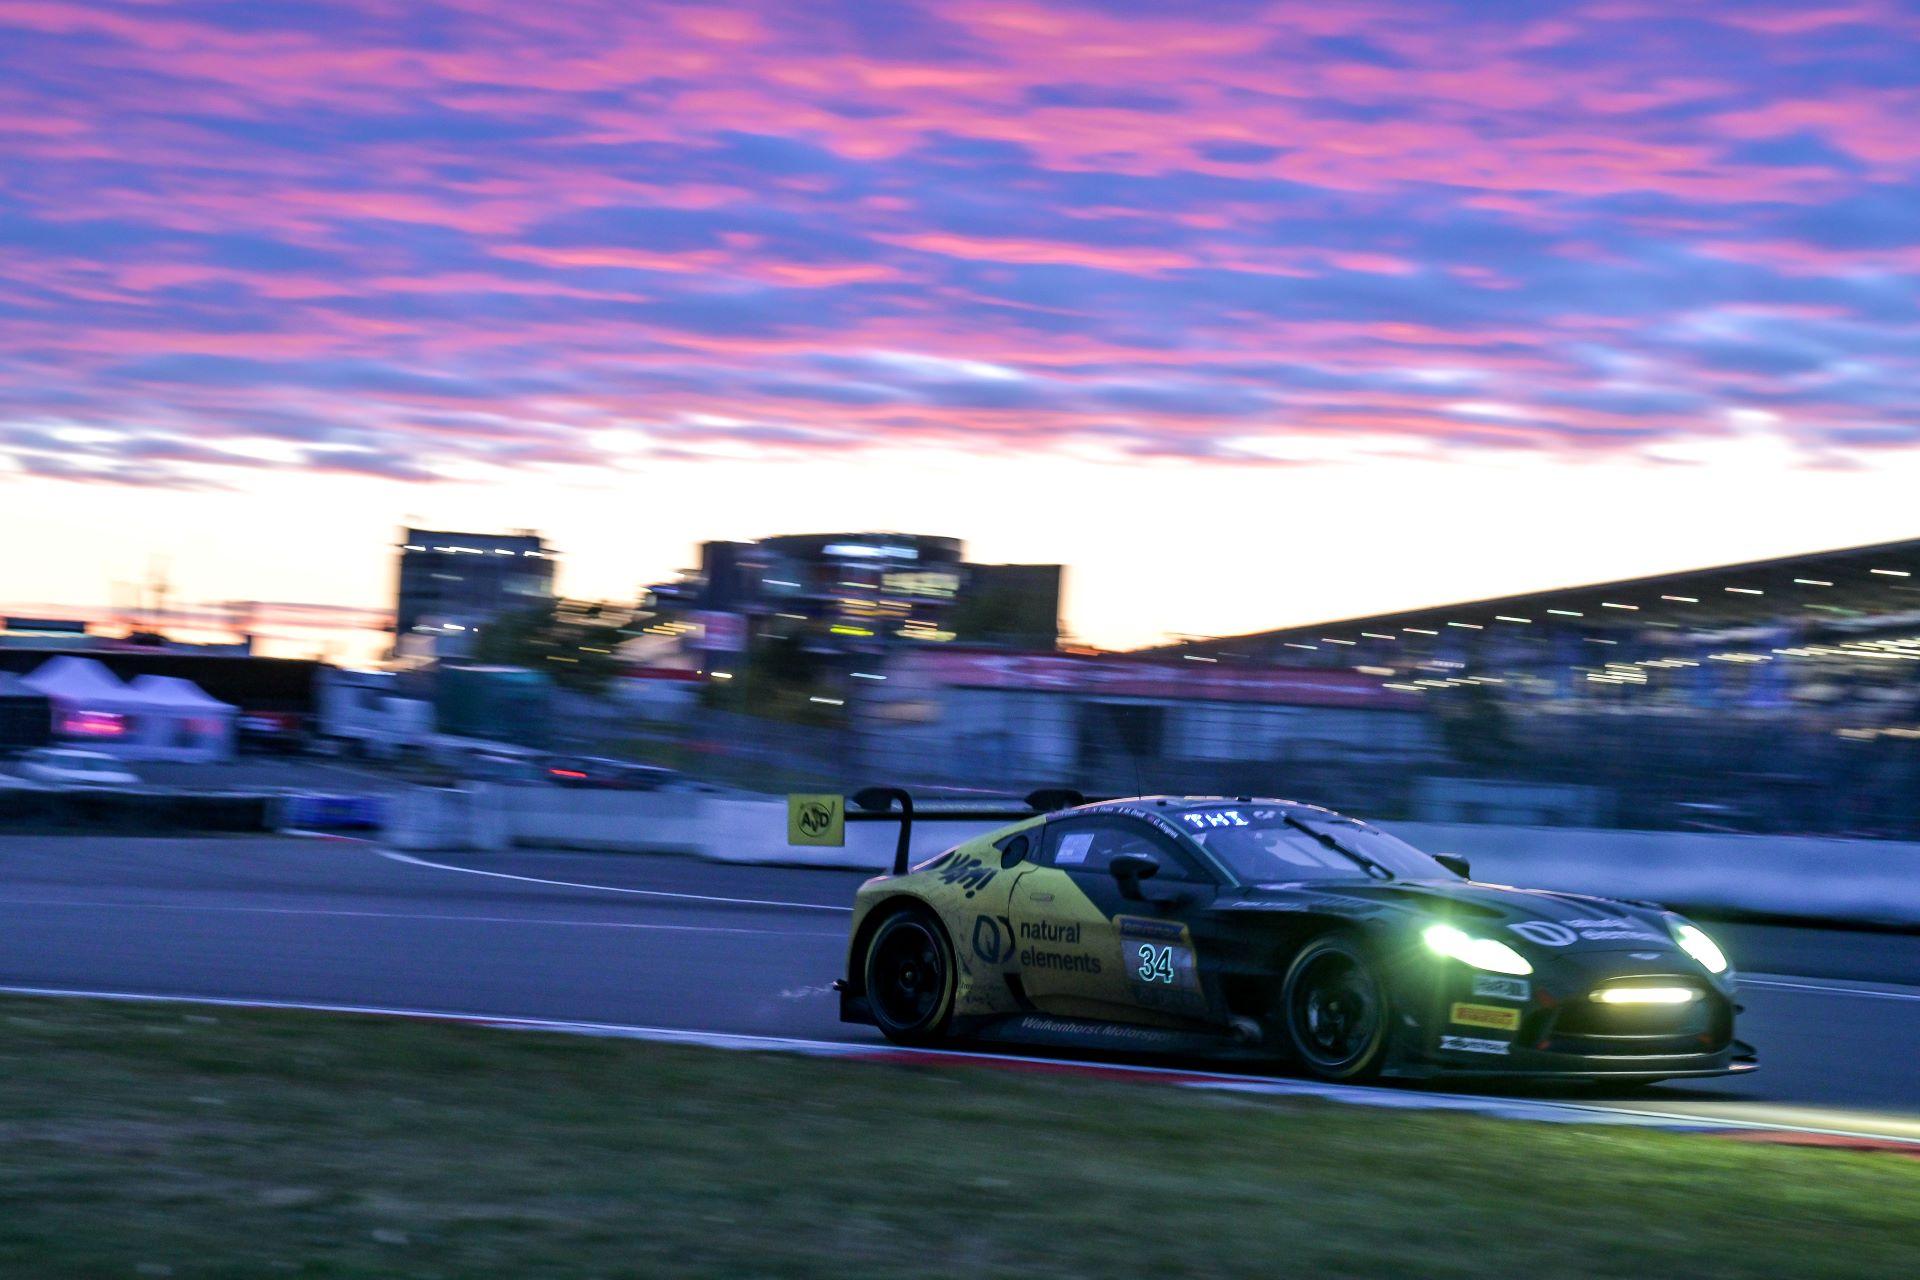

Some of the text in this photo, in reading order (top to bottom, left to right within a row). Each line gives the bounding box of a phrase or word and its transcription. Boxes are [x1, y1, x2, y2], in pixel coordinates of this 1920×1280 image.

[1021, 919, 1080, 944] natural
[1020, 945, 1102, 974] elements
[1138, 943, 1174, 984] 34
[1022, 1017, 1099, 1035] Walkenhorst
